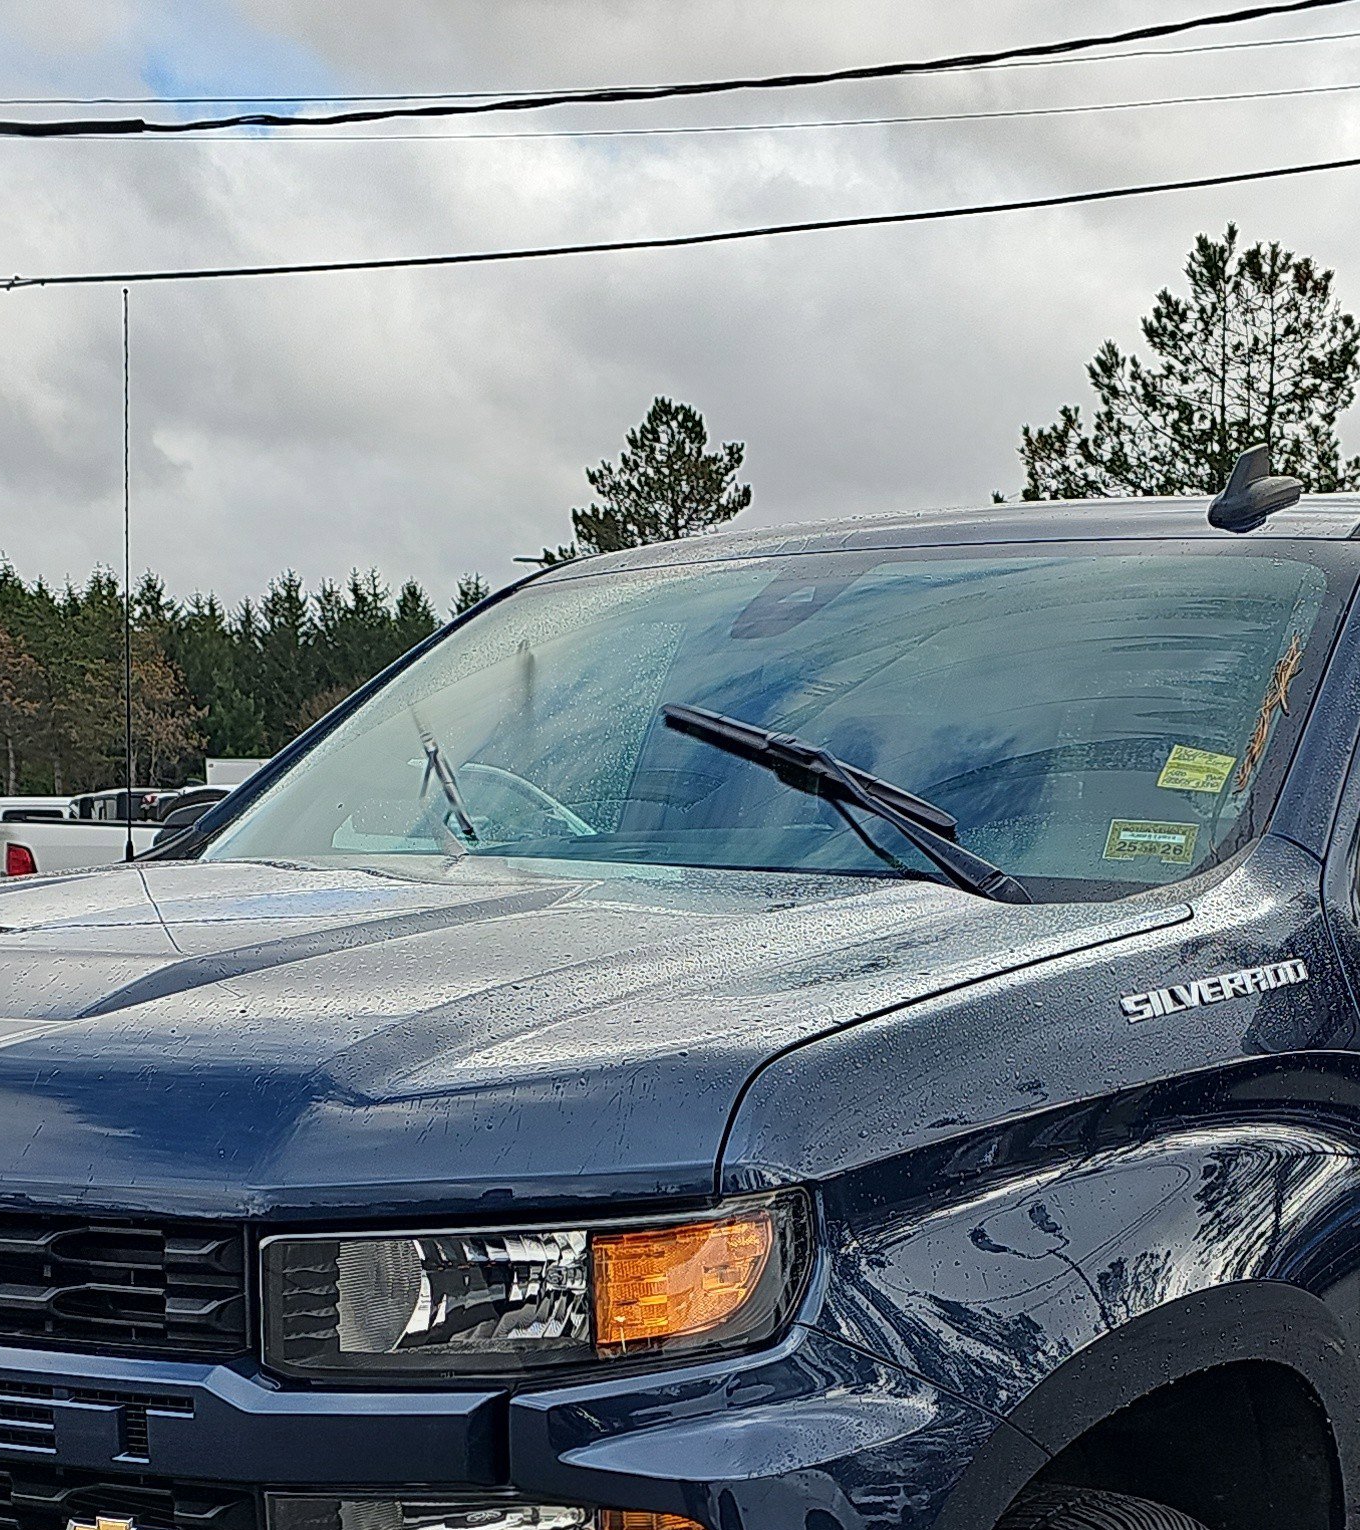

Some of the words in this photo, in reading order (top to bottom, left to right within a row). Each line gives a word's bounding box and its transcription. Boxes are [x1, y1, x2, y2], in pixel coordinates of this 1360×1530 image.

[1115, 841, 1138, 853] 25
[1160, 843, 1184, 856] 26
[1120, 959, 1309, 1024] SILVERADO
